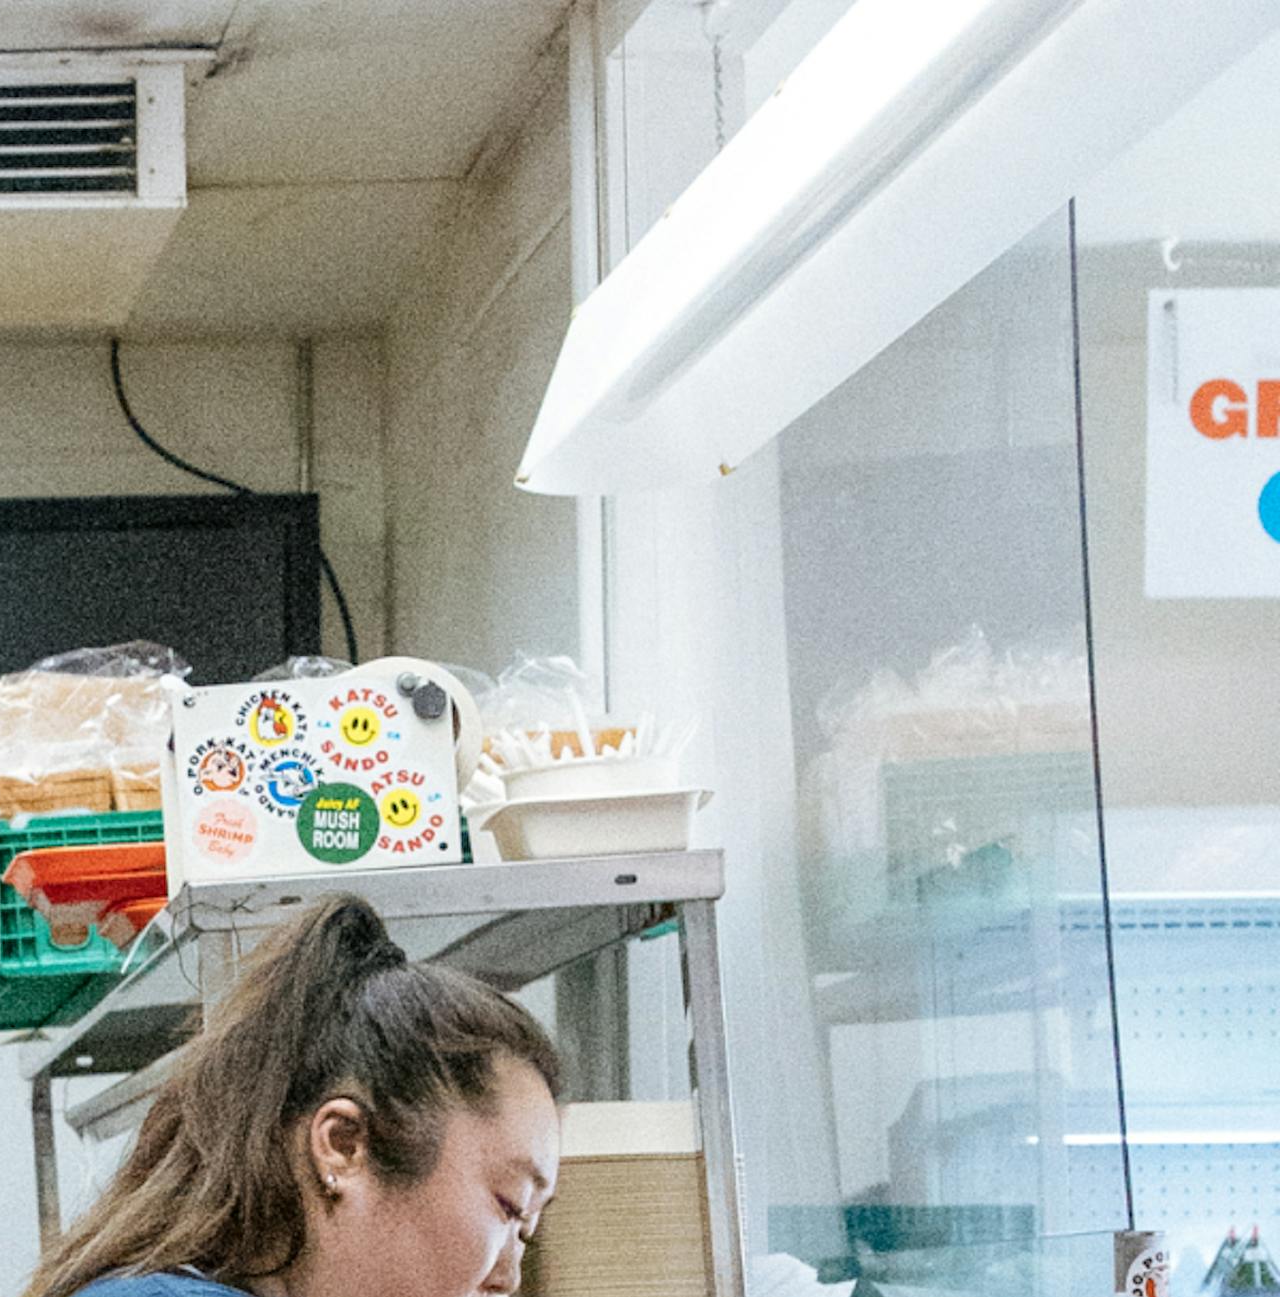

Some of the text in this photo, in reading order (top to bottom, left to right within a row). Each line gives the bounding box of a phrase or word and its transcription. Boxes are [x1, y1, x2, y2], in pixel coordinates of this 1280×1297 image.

[236, 689, 290, 726] CHICKEN
[328, 688, 398, 718] KATSU
[187, 737, 217, 779] PORK
[259, 748, 317, 771] MENCHI
[321, 740, 389, 771] SANDO
[371, 769, 426, 796] ATSU
[198, 823, 254, 844] SHRIMP
[314, 810, 360, 830] MUSH
[378, 814, 443, 853] SANDO
[313, 829, 360, 849] ROOM
